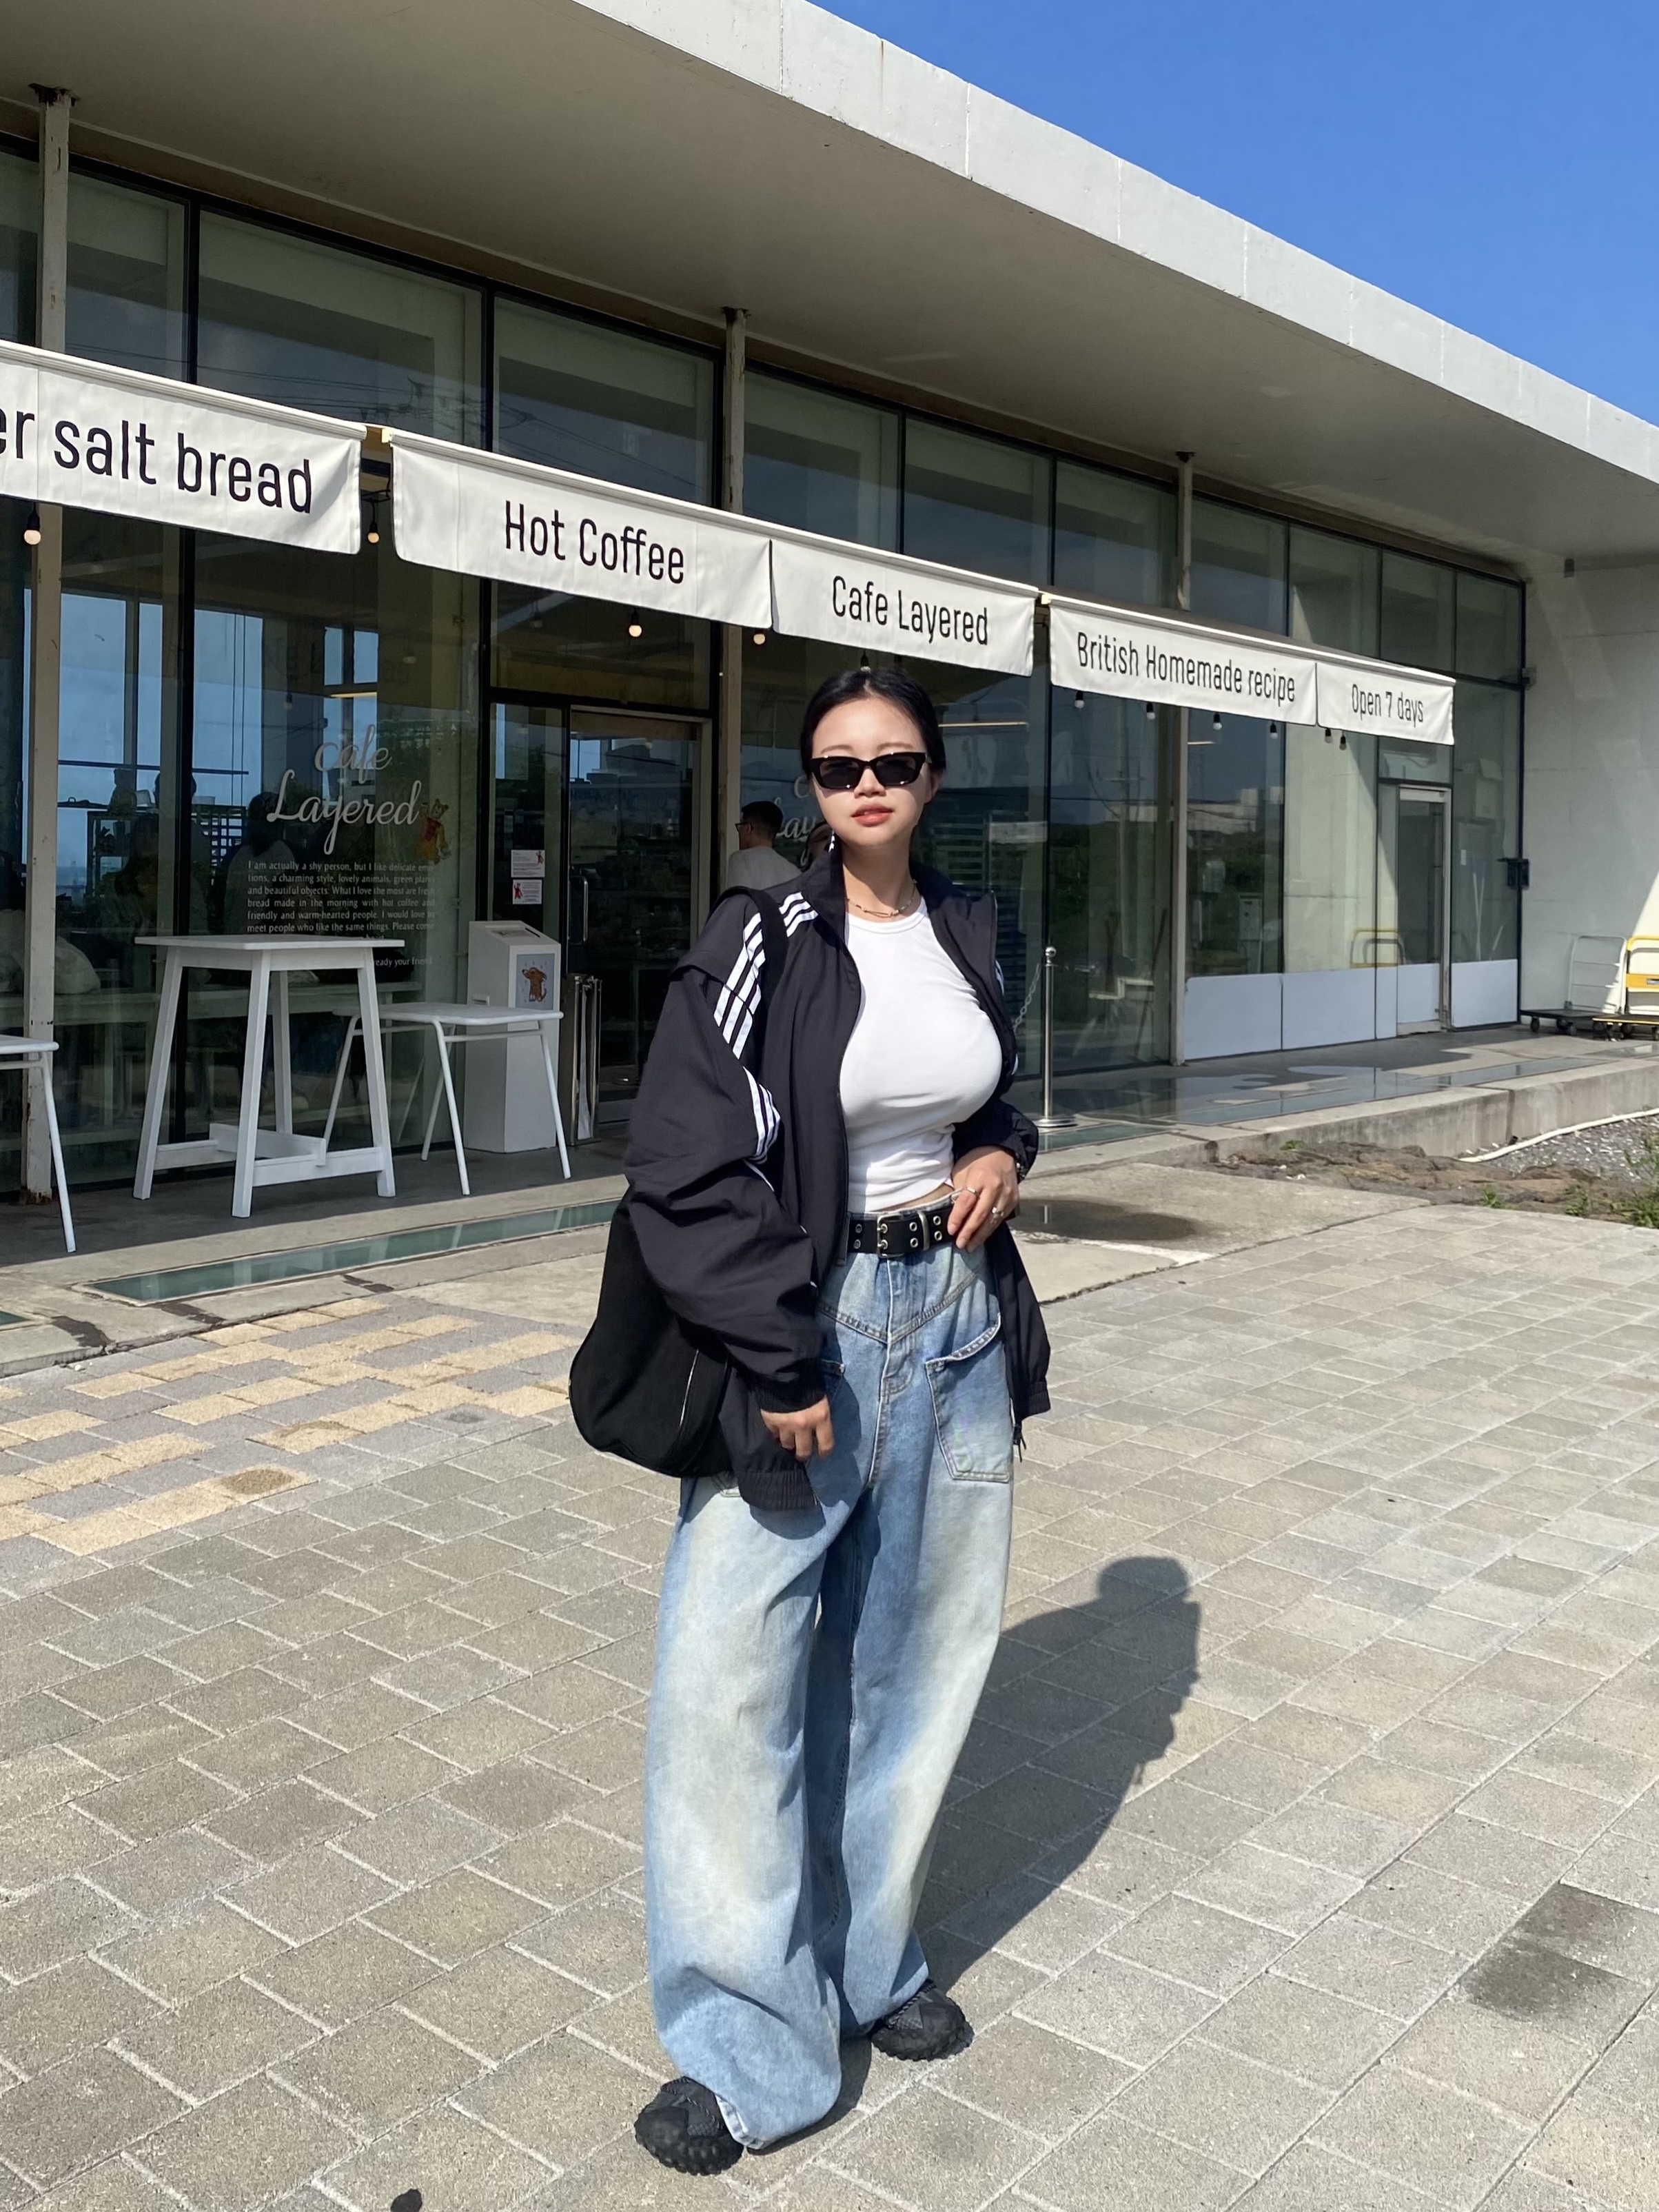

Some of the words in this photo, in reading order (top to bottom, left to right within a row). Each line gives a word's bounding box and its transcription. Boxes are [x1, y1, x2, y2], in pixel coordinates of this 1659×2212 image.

[54, 419, 156, 485] salt
[177, 432, 312, 514] bread
[505, 500, 565, 560] Hot
[579, 518, 684, 585] Coffee
[833, 576, 888, 626] Cafe
[898, 590, 988, 645] Layered
[1077, 631, 1139, 677] British
[1146, 644, 1243, 694] Homemade
[1248, 667, 1296, 703] recipe
[1351, 683, 1382, 720] Open
[1385, 691, 1393, 714] 7
[1397, 691, 1425, 728] days
[266, 769, 422, 855] Layered
[269, 861, 299, 871] actually
[309, 862, 320, 871] shy
[354, 862, 366, 871] but
[374, 862, 387, 871] like
[389, 863, 416, 871] delicate
[278, 874, 314, 884] charming
[338, 874, 359, 884] lovely
[394, 876, 413, 885] green
[247, 886, 263, 895] and
[264, 886, 299, 895] beautiful
[332, 886, 351, 895] What
[357, 886, 372, 895] love
[374, 886, 385, 895] the
[247, 898, 269, 907] bread
[274, 899, 295, 907] made
[299, 899, 307, 907] in
[311, 898, 323, 907] the
[327, 899, 358, 909] morning
[362, 899, 378, 907] with
[382, 898, 394, 906] hot
[397, 898, 418, 906] coffee
[247, 911, 278, 922] friendly
[281, 911, 295, 920] and
[298, 911, 349, 920] warm-hearted
[387, 910, 409, 918] would
[411, 910, 425, 918] love
[269, 923, 295, 933] people
[297, 923, 314, 931] who
[316, 922, 329, 931] like
[332, 922, 343, 931] the
[392, 922, 414, 930] Please
[394, 959, 410, 968] your
